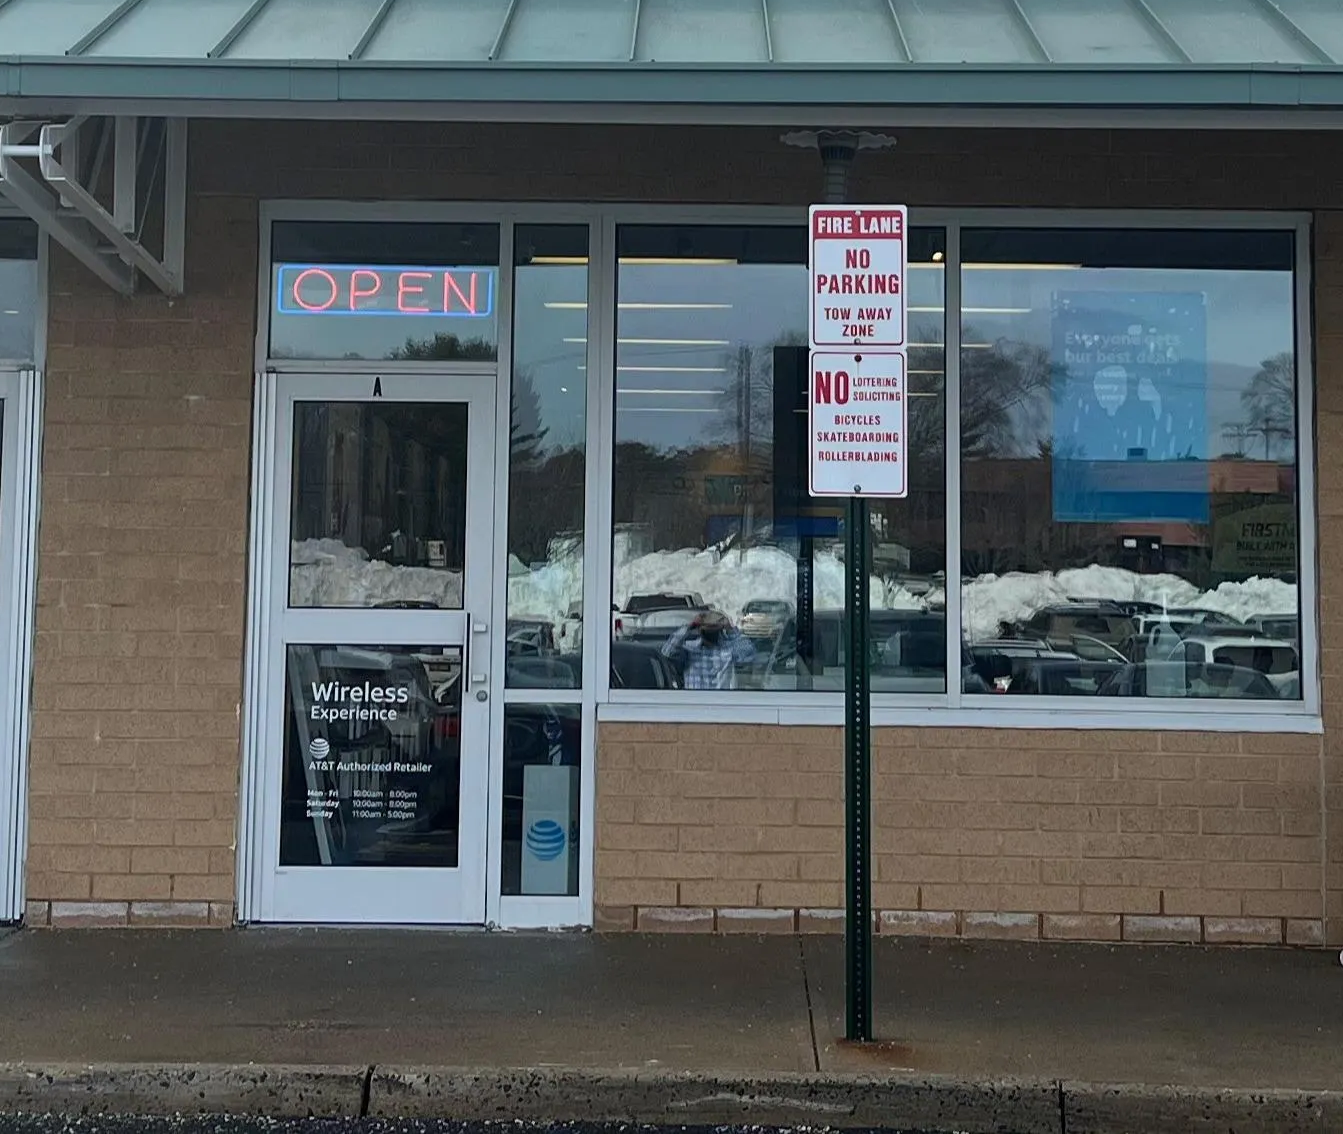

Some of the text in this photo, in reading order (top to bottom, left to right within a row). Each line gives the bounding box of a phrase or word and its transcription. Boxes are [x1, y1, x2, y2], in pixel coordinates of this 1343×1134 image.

[817, 216, 902, 234] FIRE LANE
[845, 248, 870, 269] NO
[293, 268, 477, 314] OPEN
[817, 274, 900, 294] PARKING
[824, 307, 892, 320] TOW AWAY
[842, 324, 874, 337] ZONE
[372, 376, 382, 397] A
[816, 370, 897, 405] NO LOITERING
[853, 391, 901, 401] SOLICITING
[834, 415, 881, 426] BICYCLES
[817, 431, 899, 443] SKATEBOARDING
[818, 450, 898, 462] ROLLERBLADING
[312, 681, 408, 703] Wireless
[311, 705, 397, 723] Experience
[308, 761, 432, 772] AT&T Authorized Retailer
